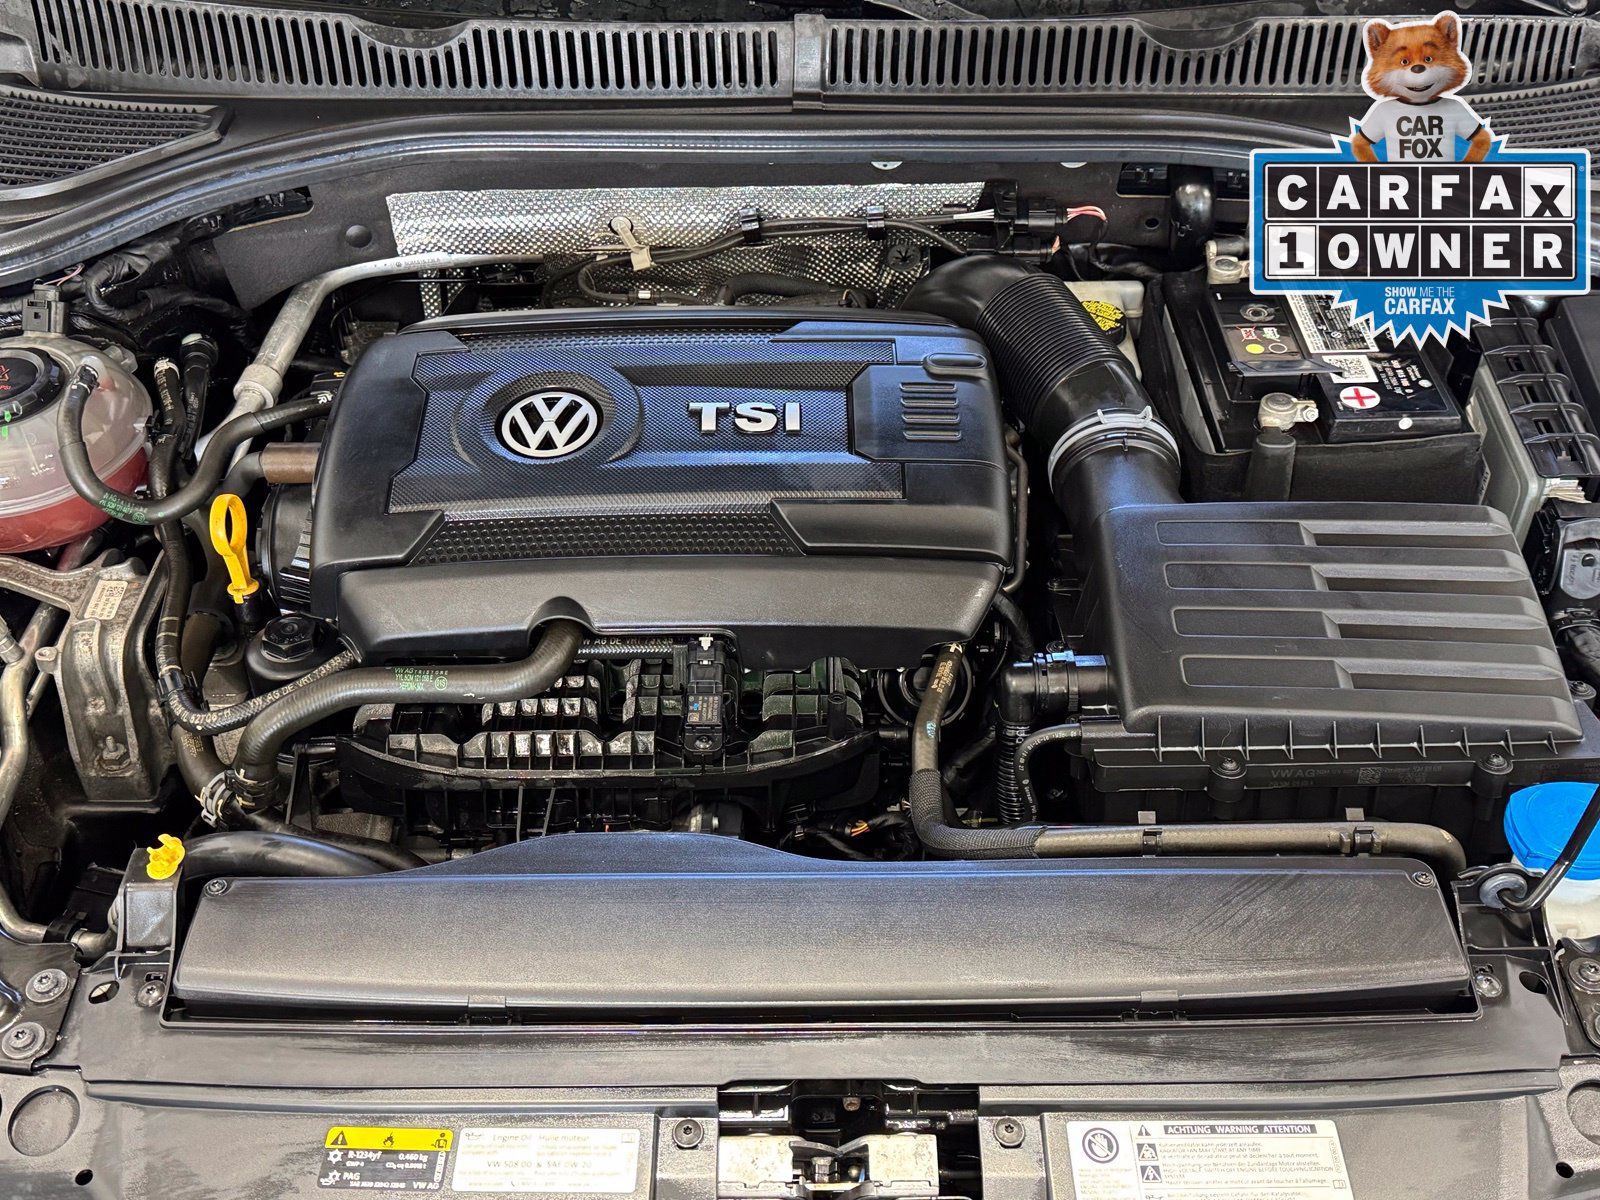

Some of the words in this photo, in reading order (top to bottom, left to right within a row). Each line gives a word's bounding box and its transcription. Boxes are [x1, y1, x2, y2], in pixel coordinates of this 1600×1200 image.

[687, 401, 801, 435] TSI
[501, 391, 598, 457] VW
[266, 691, 281, 703] AG
[283, 684, 298, 696] DE
[1271, 769, 1294, 778] VW
[1295, 768, 1316, 777] AG
[1167, 1125, 1211, 1134] ACHTUNG
[1215, 1125, 1259, 1133] WARNING
[1263, 1125, 1312, 1133] ATTENTION
[347, 1151, 382, 1161] R-1234yf
[343, 1172, 361, 1180] PAG
